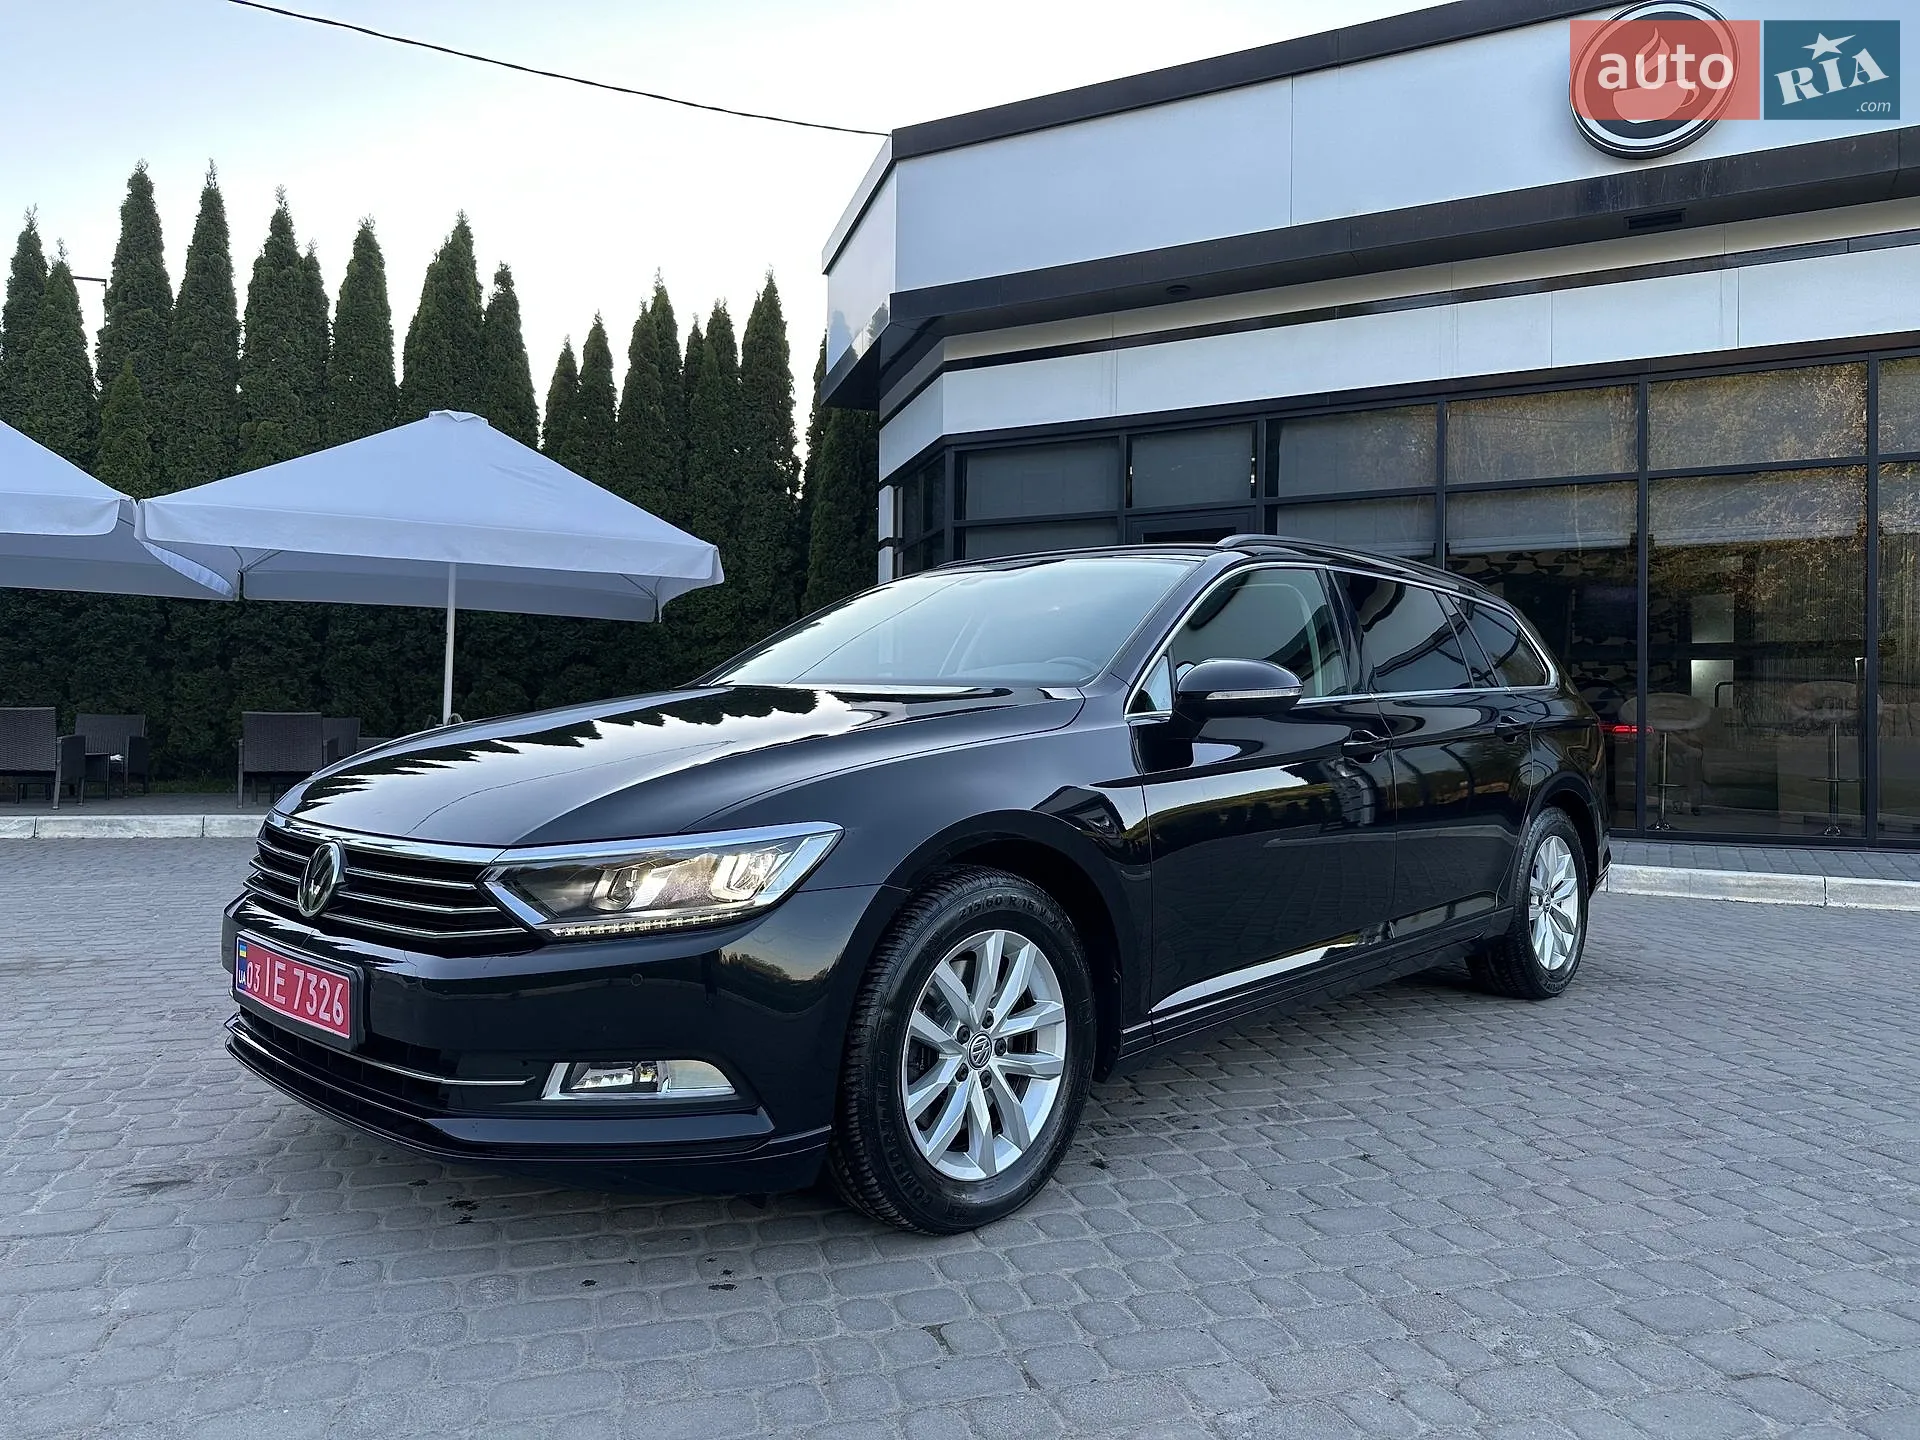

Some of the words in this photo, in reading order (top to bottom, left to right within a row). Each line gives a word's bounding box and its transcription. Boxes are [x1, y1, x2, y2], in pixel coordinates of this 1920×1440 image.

[238, 970, 247, 986] UA
[246, 961, 261, 993] 03
[265, 957, 286, 1005] IE
[293, 968, 344, 1026] 7326
